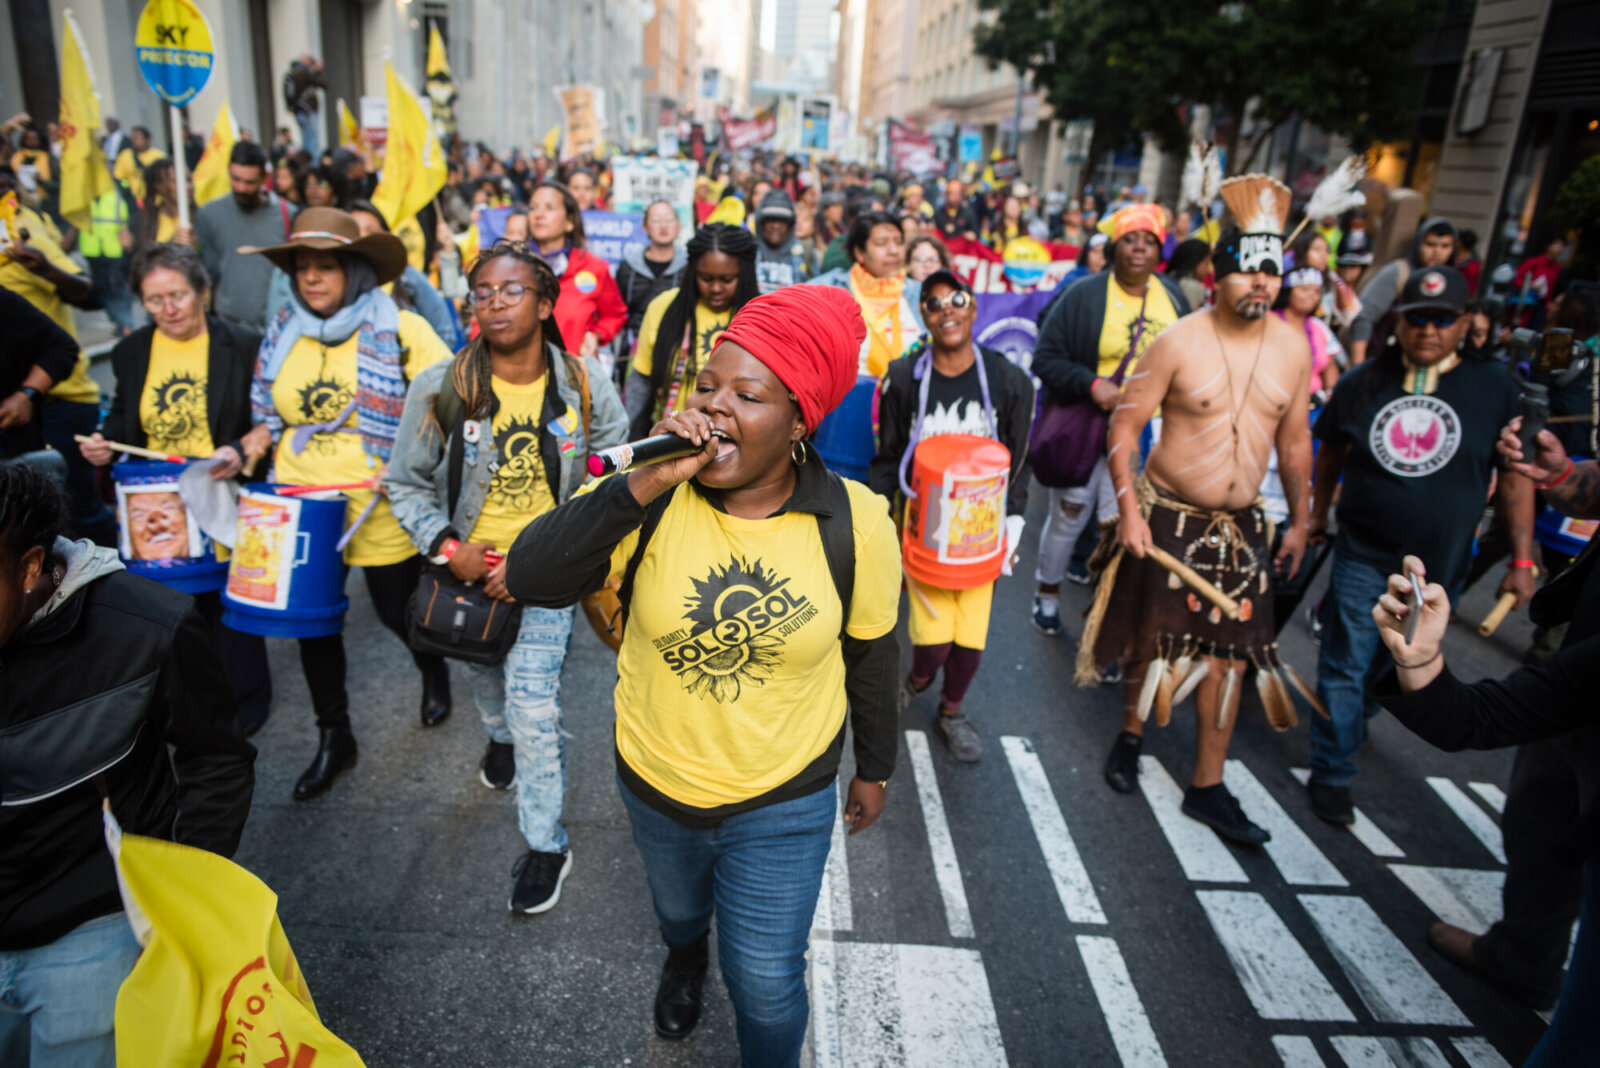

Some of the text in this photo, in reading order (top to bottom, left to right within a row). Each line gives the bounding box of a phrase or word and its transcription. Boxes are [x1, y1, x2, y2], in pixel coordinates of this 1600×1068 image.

[155, 24, 189, 45] SKY
[515, 458, 525, 470] 2
[663, 588, 807, 671] SOL 2 SOL
[778, 604, 819, 638] SOLUTIONS
[652, 628, 689, 650] SOLIDARITY
